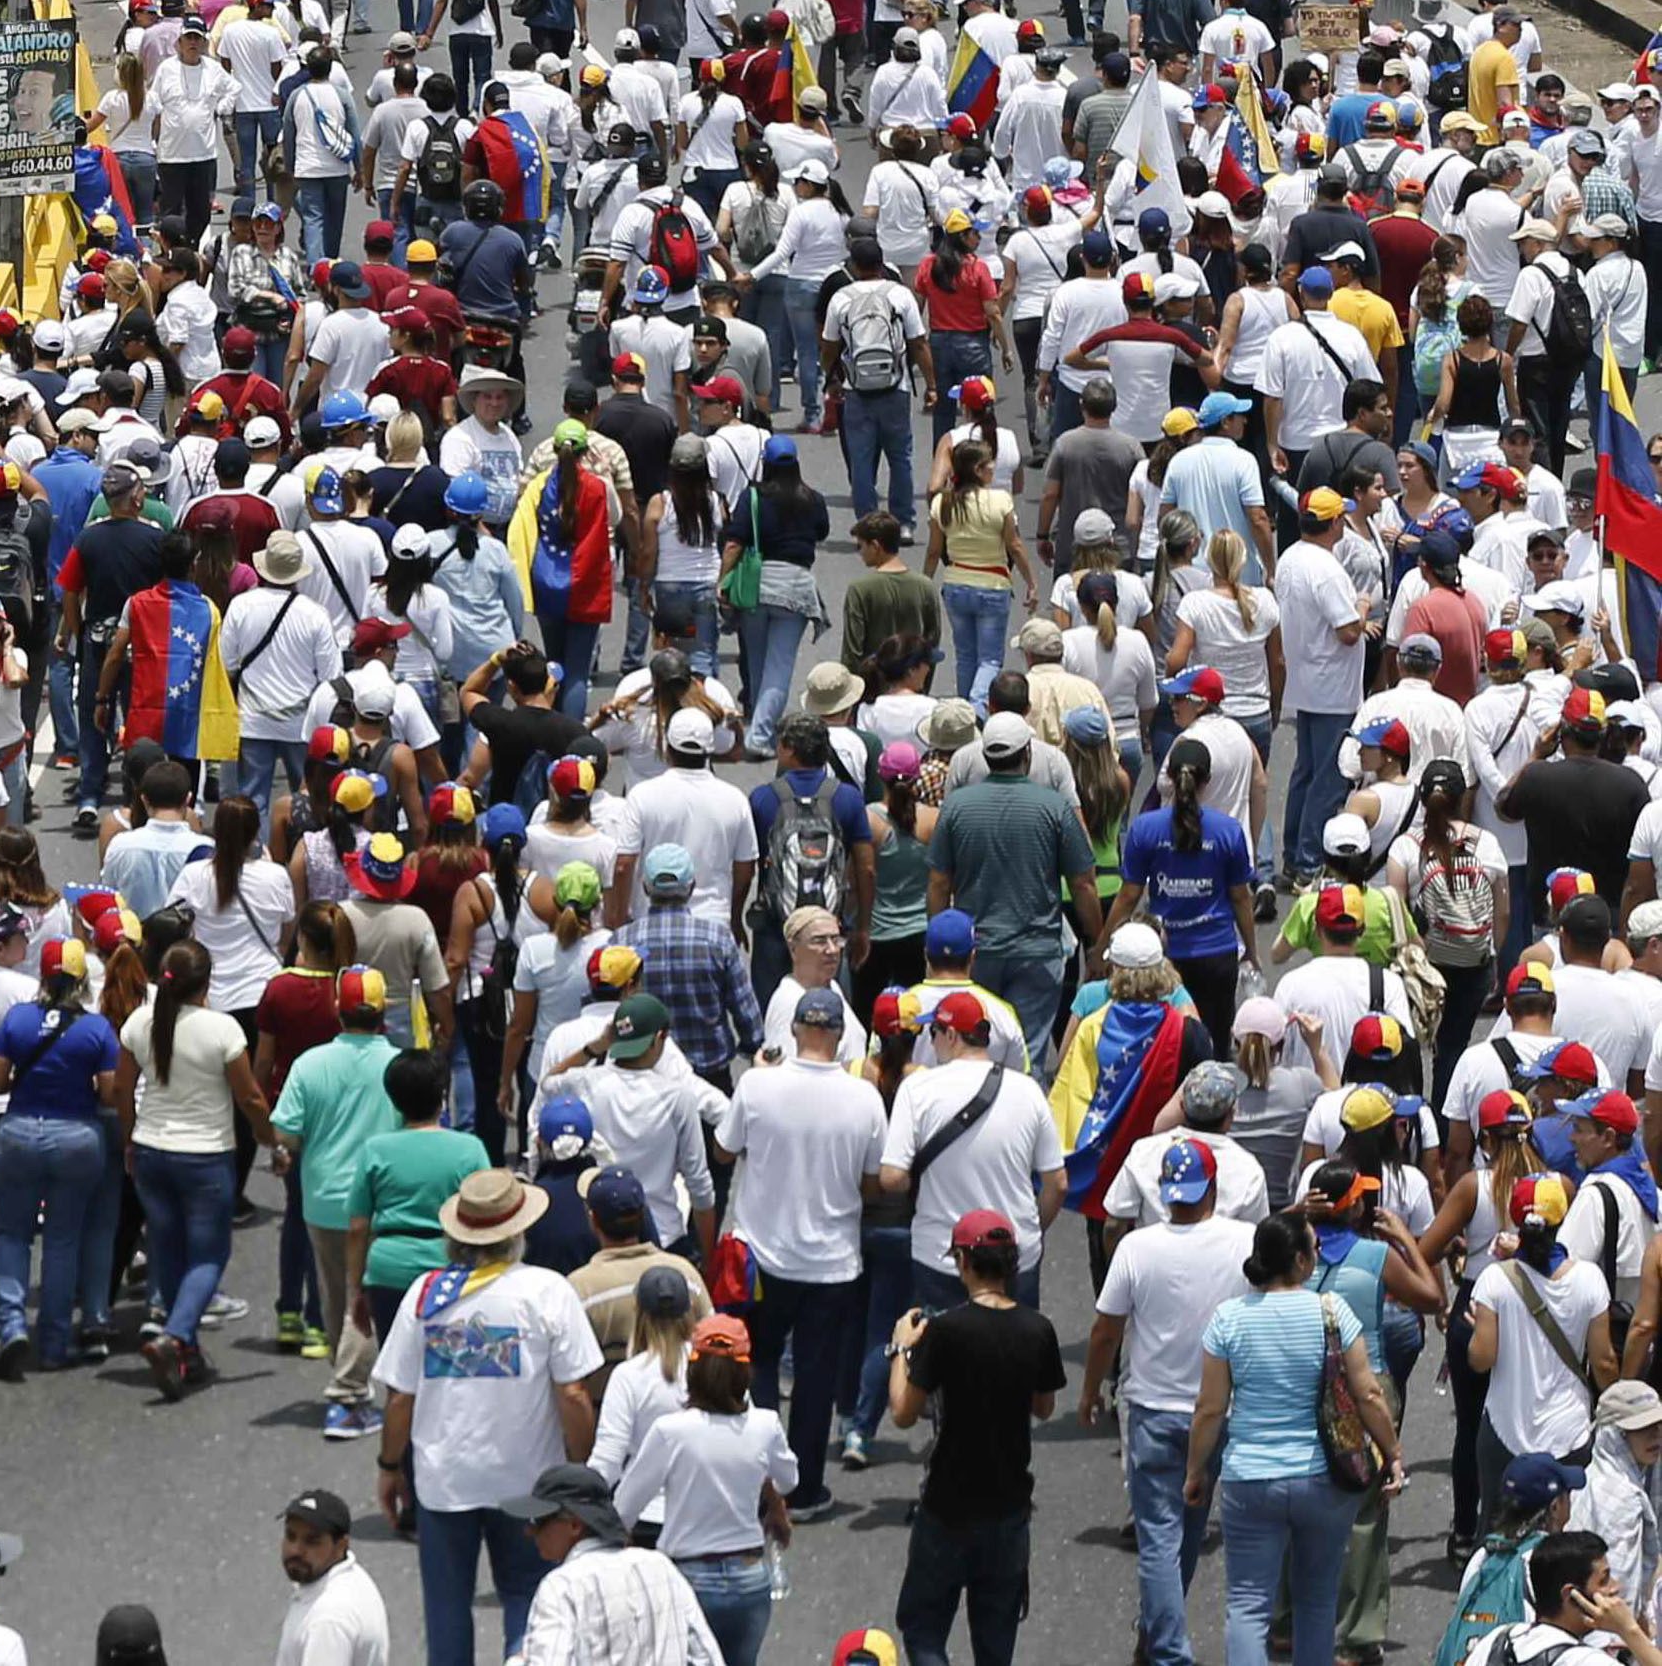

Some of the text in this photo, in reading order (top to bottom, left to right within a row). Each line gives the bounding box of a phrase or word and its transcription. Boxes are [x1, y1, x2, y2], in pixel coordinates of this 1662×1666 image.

[16, 49, 69, 65] ASUSTAO
[6, 149, 26, 161] SANTA
[46, 145, 56, 156] DE
[57, 145, 73, 156] LIMA
[11, 155, 73, 175] 660.44.60
